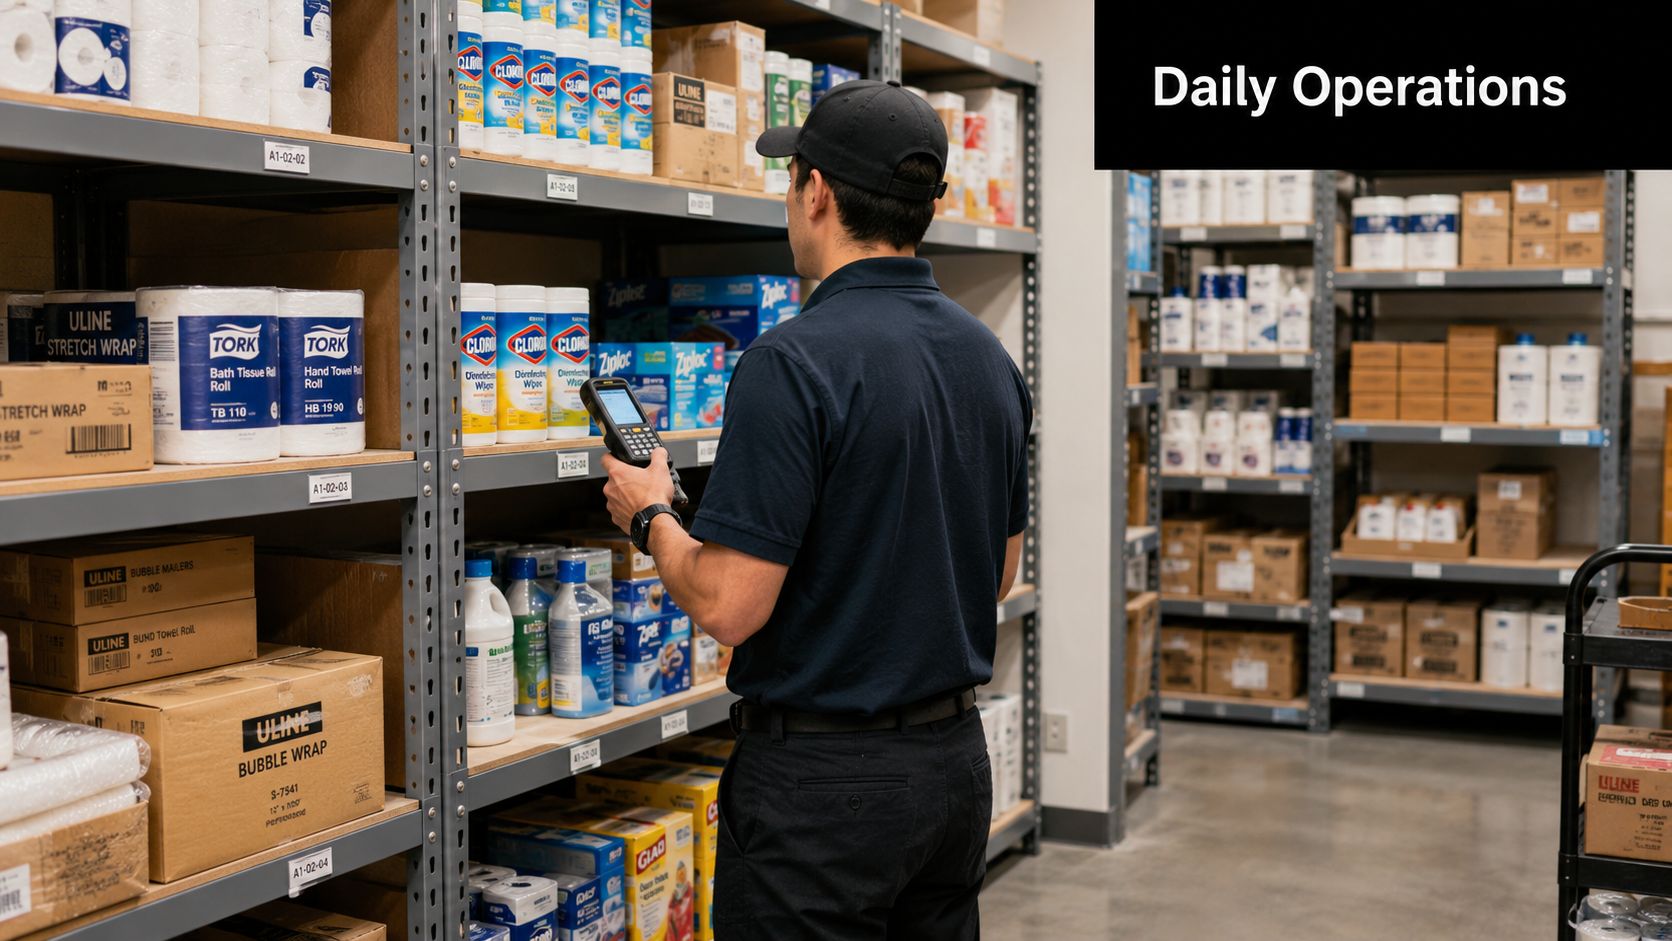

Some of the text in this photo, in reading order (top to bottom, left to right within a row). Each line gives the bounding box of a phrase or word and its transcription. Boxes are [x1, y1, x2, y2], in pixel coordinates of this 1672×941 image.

[269, 150, 306, 165] A1-02-02
[69, 310, 112, 331] ULINE
[47, 338, 97, 356] STRETCH
[100, 338, 137, 356] WRAP
[212, 337, 257, 352] TORK
[307, 337, 346, 352] TORK
[304, 366, 329, 377] Hand
[331, 365, 352, 376] Towel
[599, 351, 632, 377] Ziploc
[210, 367, 234, 379] Bath
[237, 367, 265, 378] Tissue
[210, 380, 231, 392] Roll
[304, 378, 323, 389] Roll
[0, 403, 86, 420] TRETCH WRAP
[211, 407, 247, 417] TB 110
[305, 404, 319, 413] HB
[313, 481, 348, 494] A1-02-03
[89, 568, 122, 585] ULINE
[93, 636, 125, 651] ULINE
[256, 709, 310, 744] ULINE
[238, 739, 328, 778] BUBBLE WRAP
[271, 783, 298, 800] S-7541
[293, 858, 329, 878] A1-02-04
